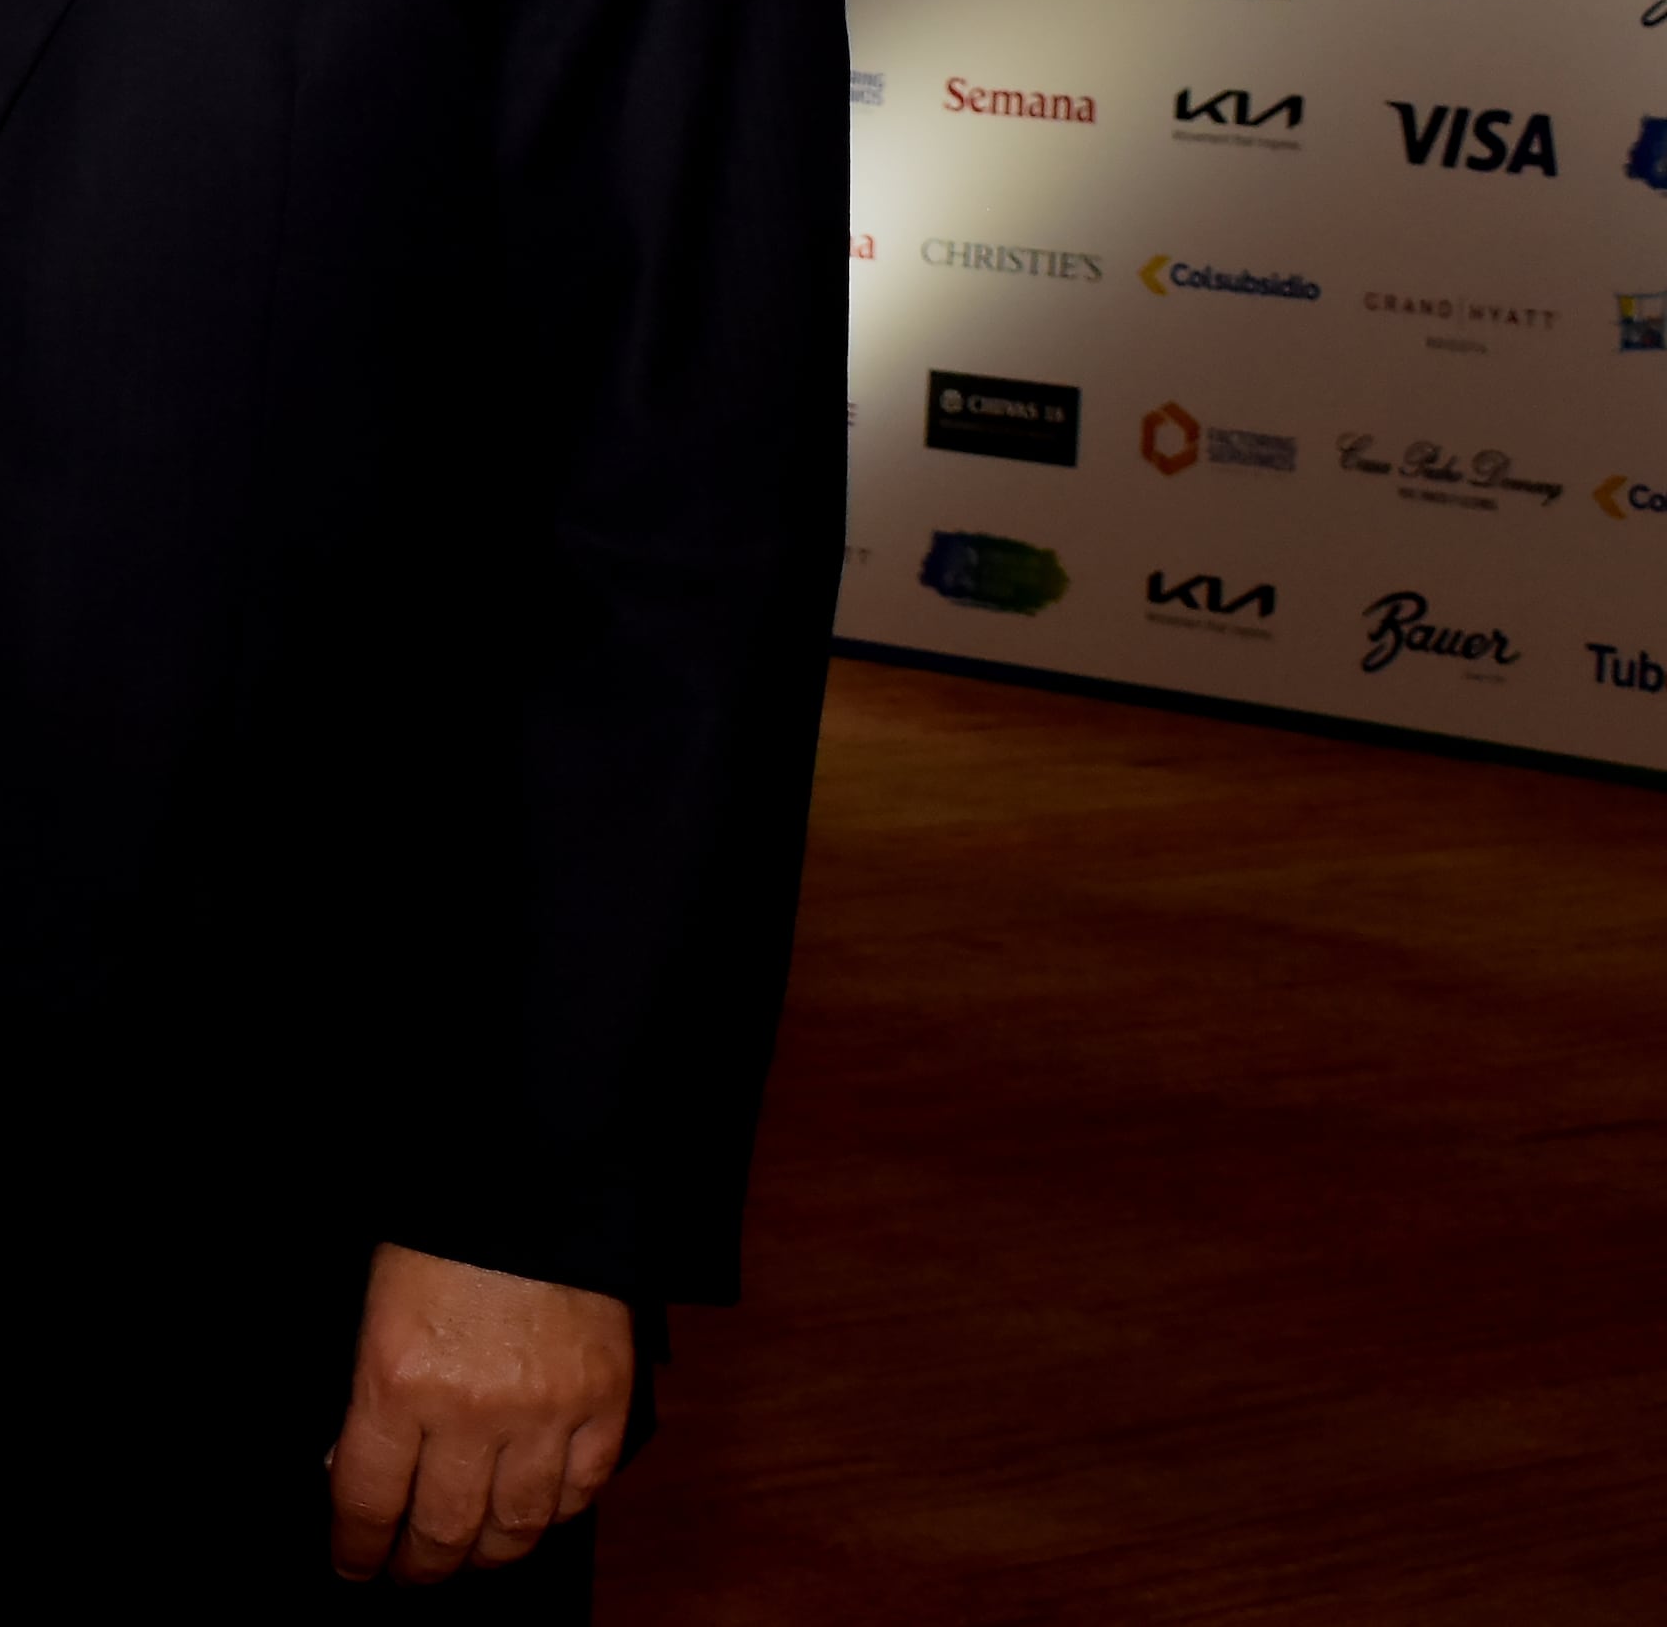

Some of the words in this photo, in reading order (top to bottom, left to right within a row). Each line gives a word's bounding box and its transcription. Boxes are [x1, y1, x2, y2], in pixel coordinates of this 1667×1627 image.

[944, 78, 1097, 124] Semana
[1174, 88, 1305, 129] KIA
[1386, 100, 1559, 177] VISA
[920, 238, 1104, 283] CHRISTIE'S
[1170, 263, 1322, 301] Colsubsidio
[1364, 292, 1455, 320] GRAND
[1146, 570, 1278, 618] KIA
[1361, 591, 1521, 674] Bauer
